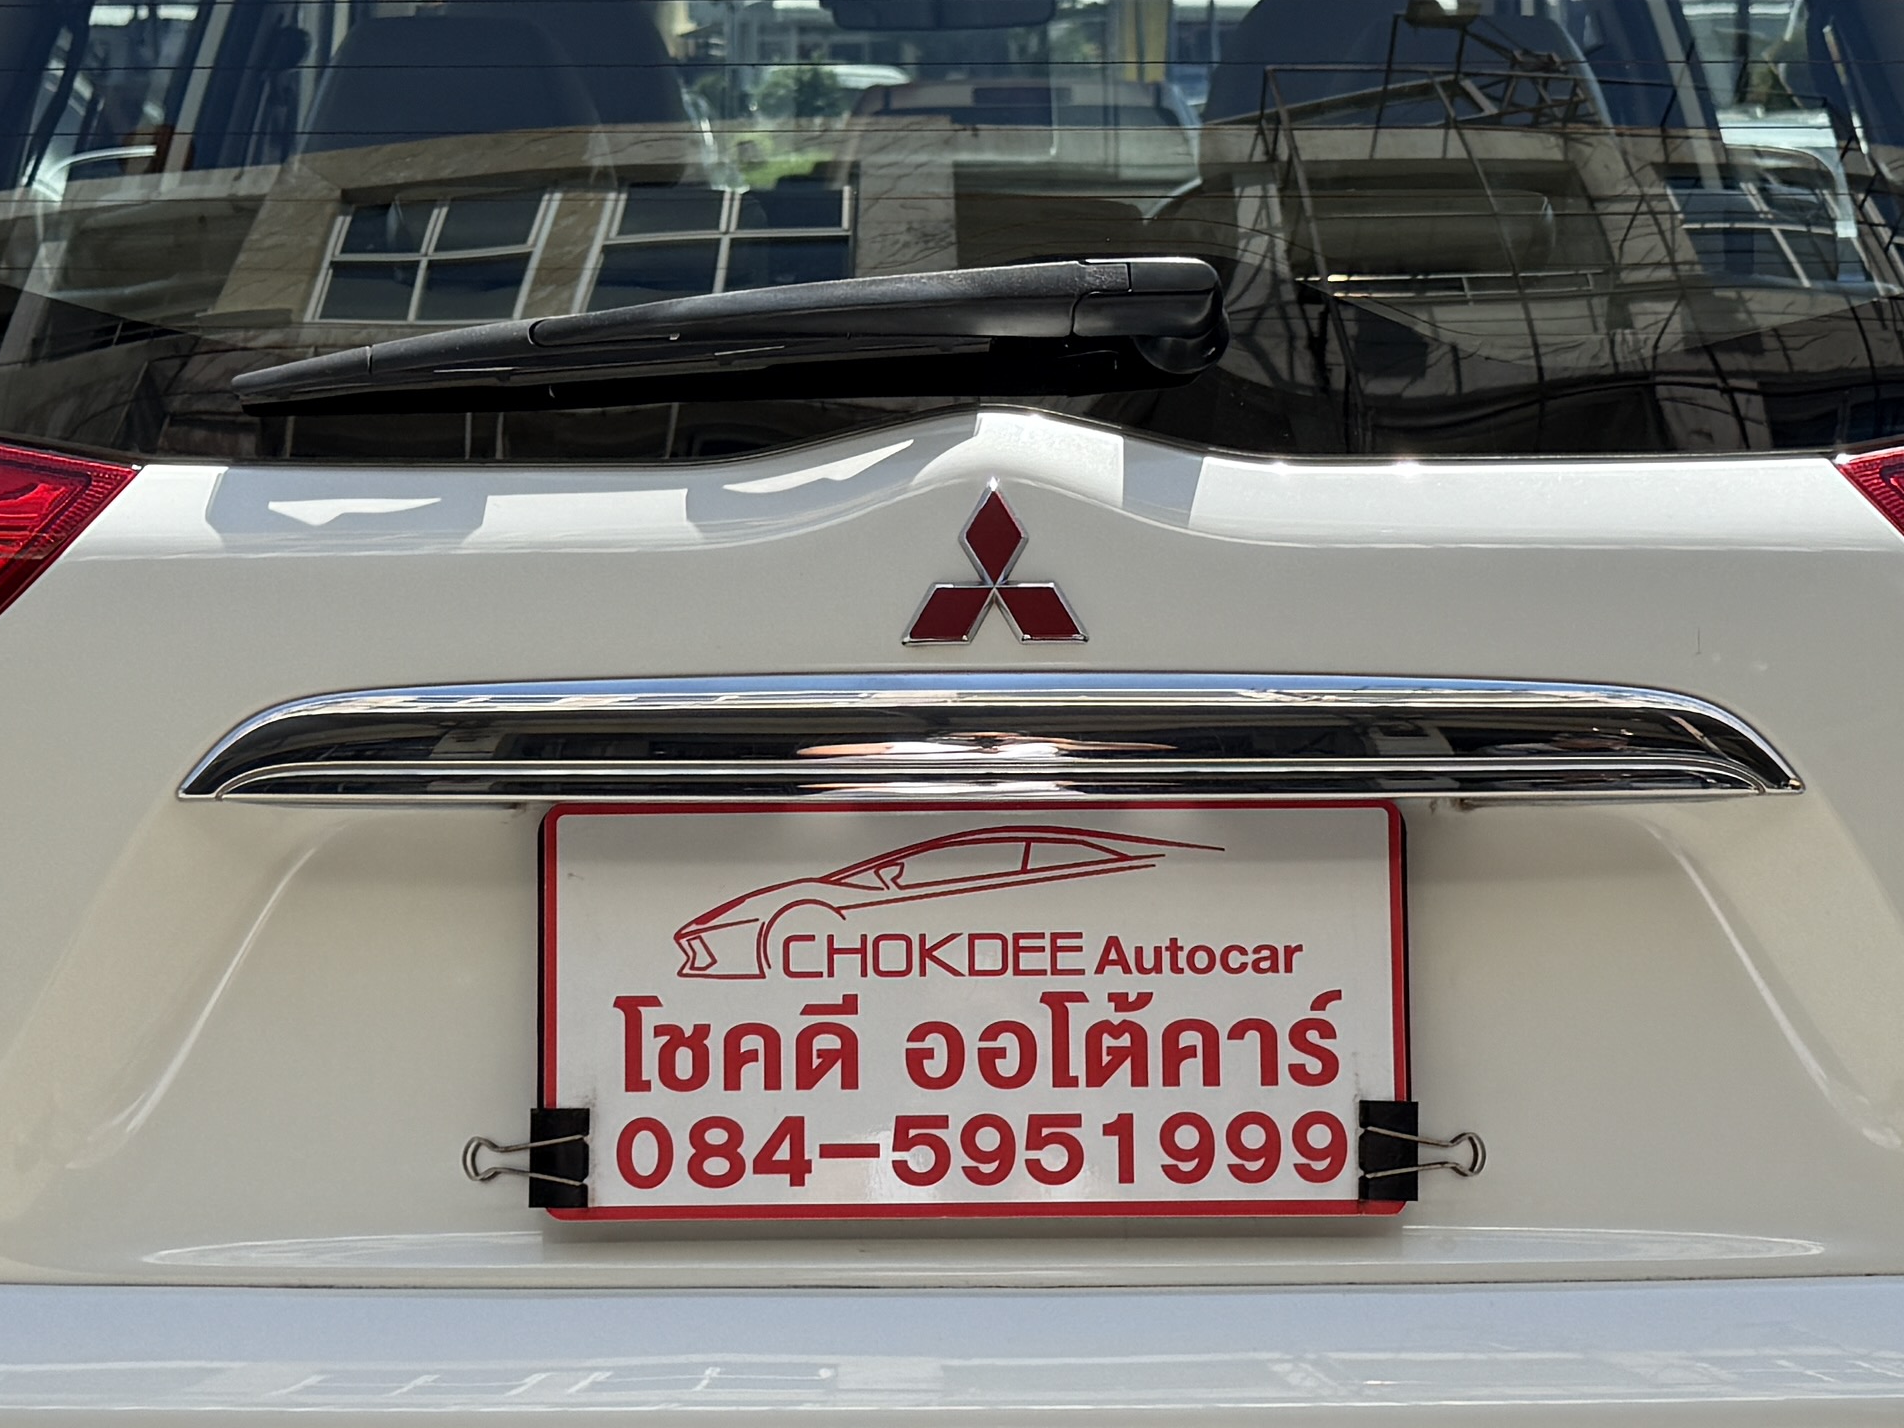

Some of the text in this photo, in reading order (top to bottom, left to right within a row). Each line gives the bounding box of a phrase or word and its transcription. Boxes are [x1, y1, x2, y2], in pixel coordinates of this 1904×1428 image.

[782, 932, 1304, 979] CHOKDEE Autocar
[613, 989, 1343, 1094] โชคดี ออโต้คาร์
[615, 1110, 1350, 1190] 084-5951999
